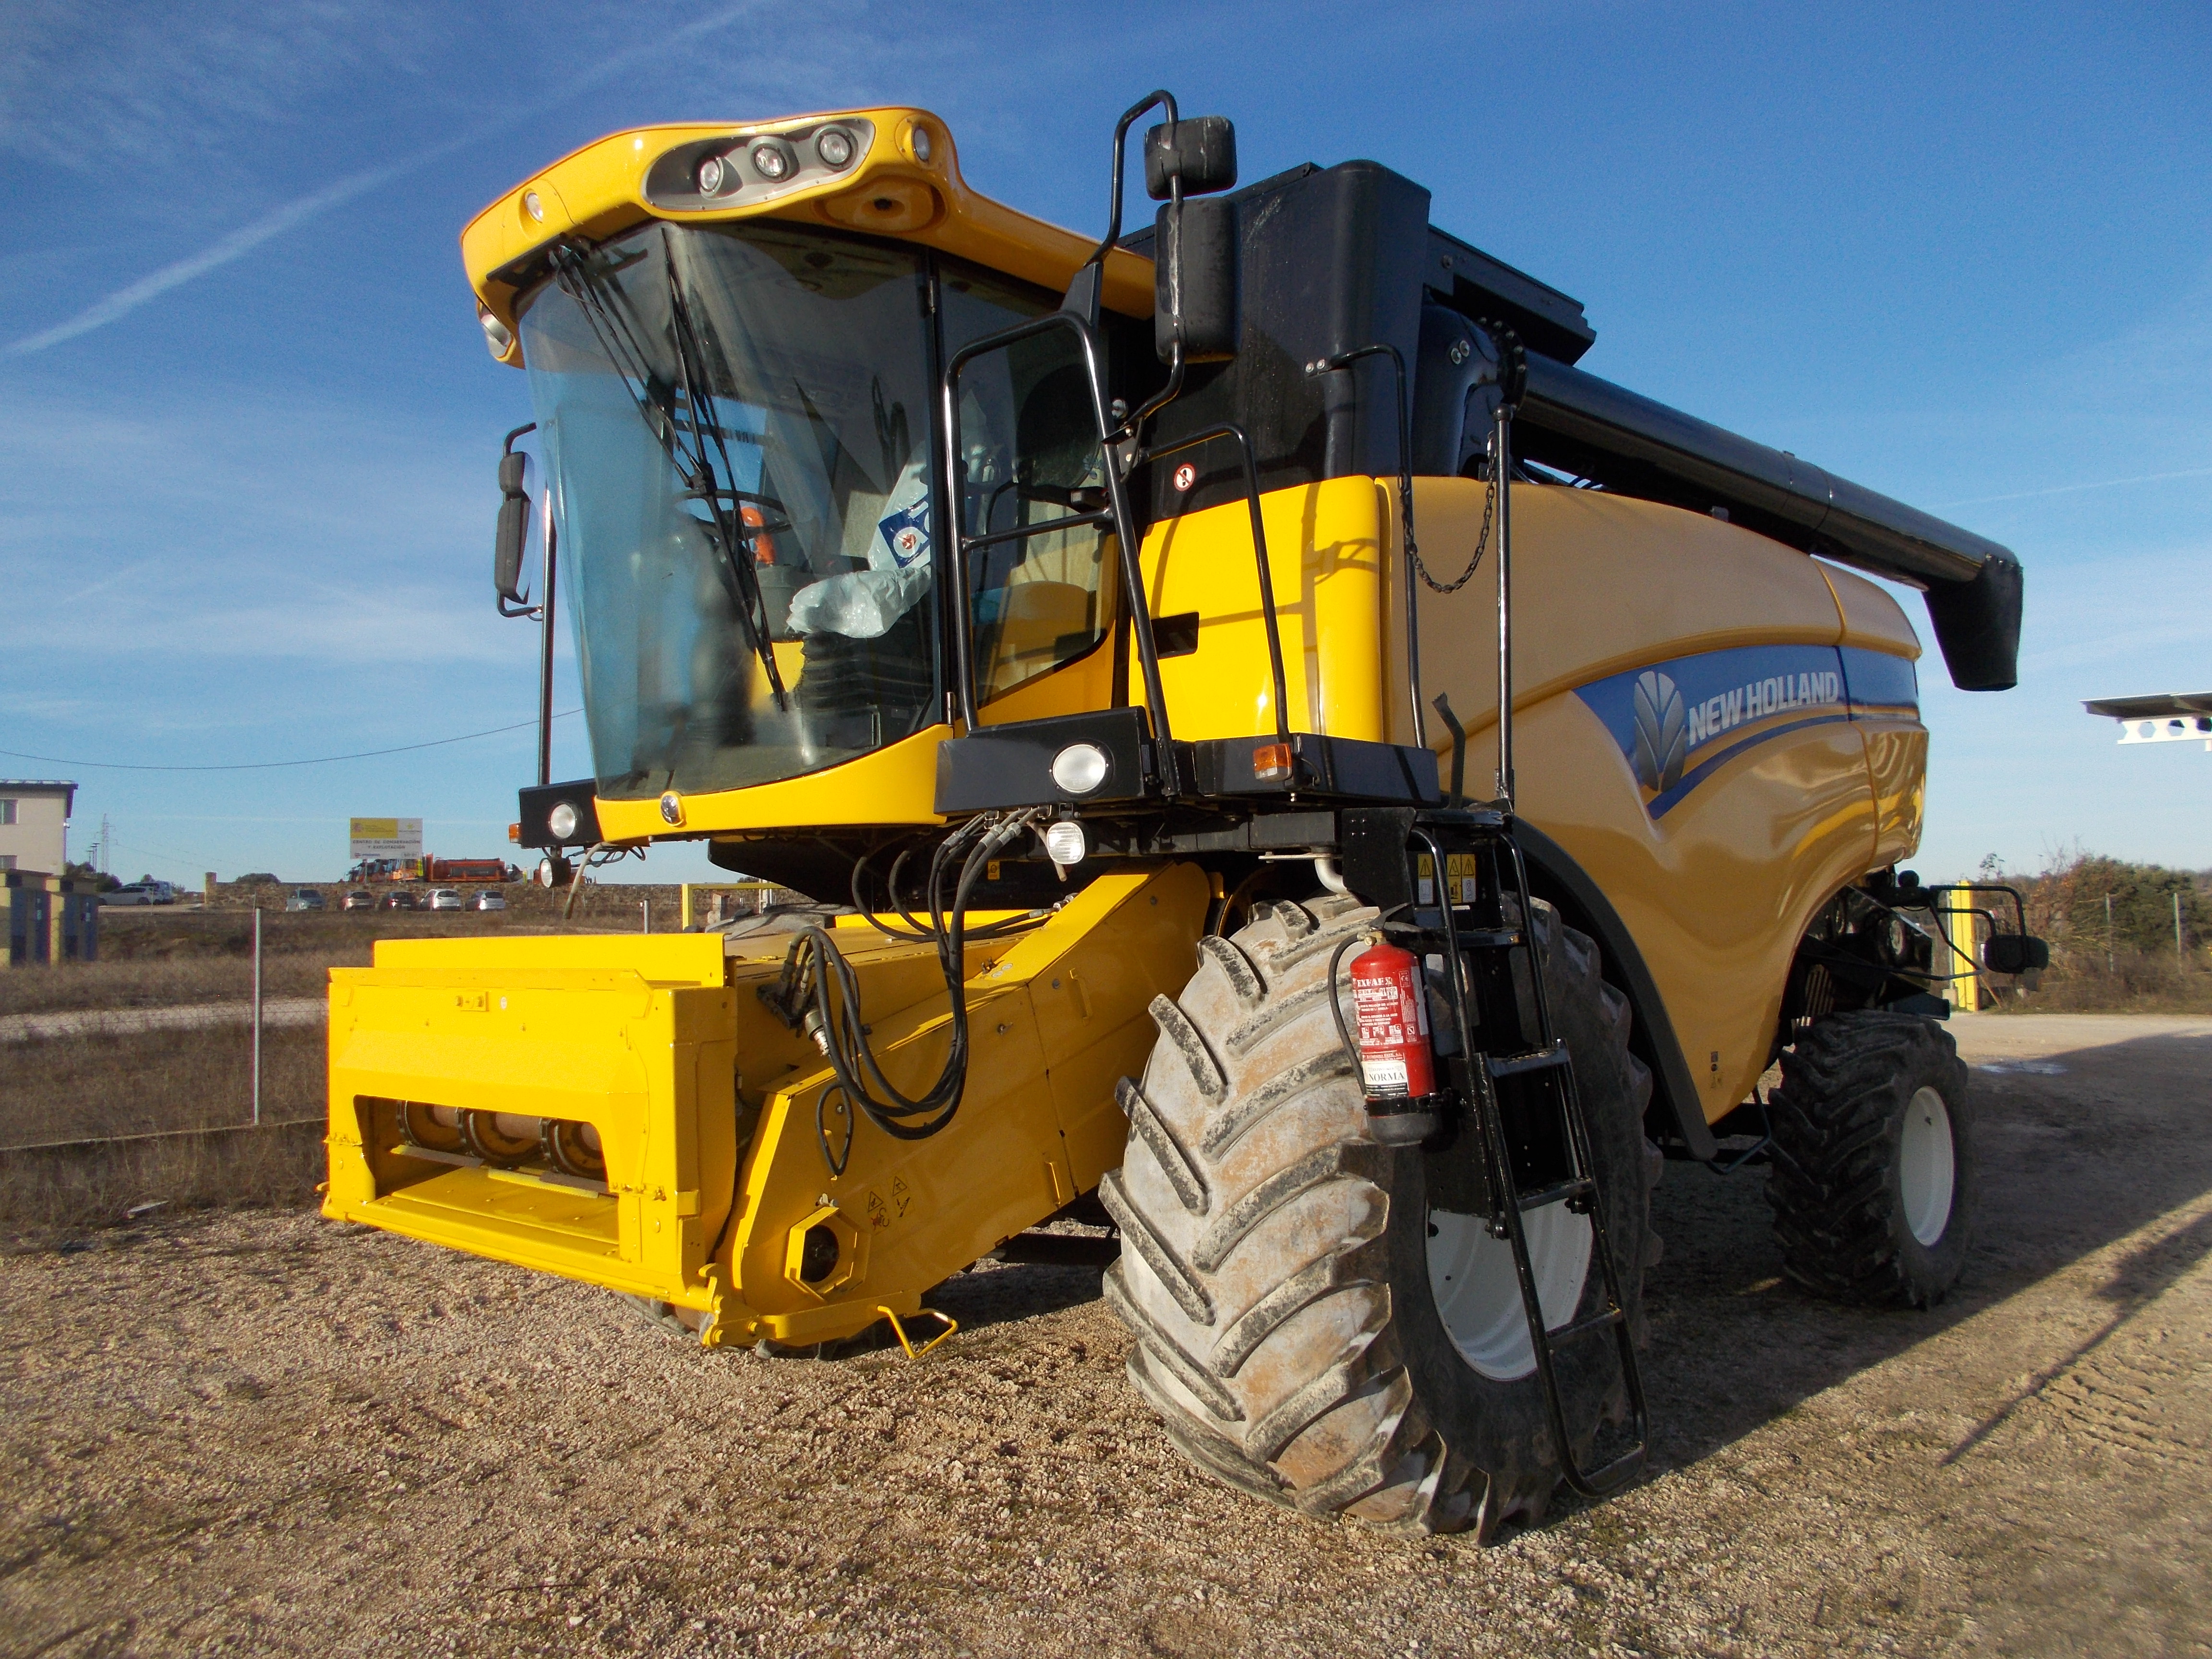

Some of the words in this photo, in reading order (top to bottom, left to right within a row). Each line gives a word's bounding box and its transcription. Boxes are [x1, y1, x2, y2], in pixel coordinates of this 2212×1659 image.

[1689, 688, 1743, 746] NEW
[1746, 672, 1838, 719] HOLLAND
[1369, 1072, 1405, 1082] NORMA
